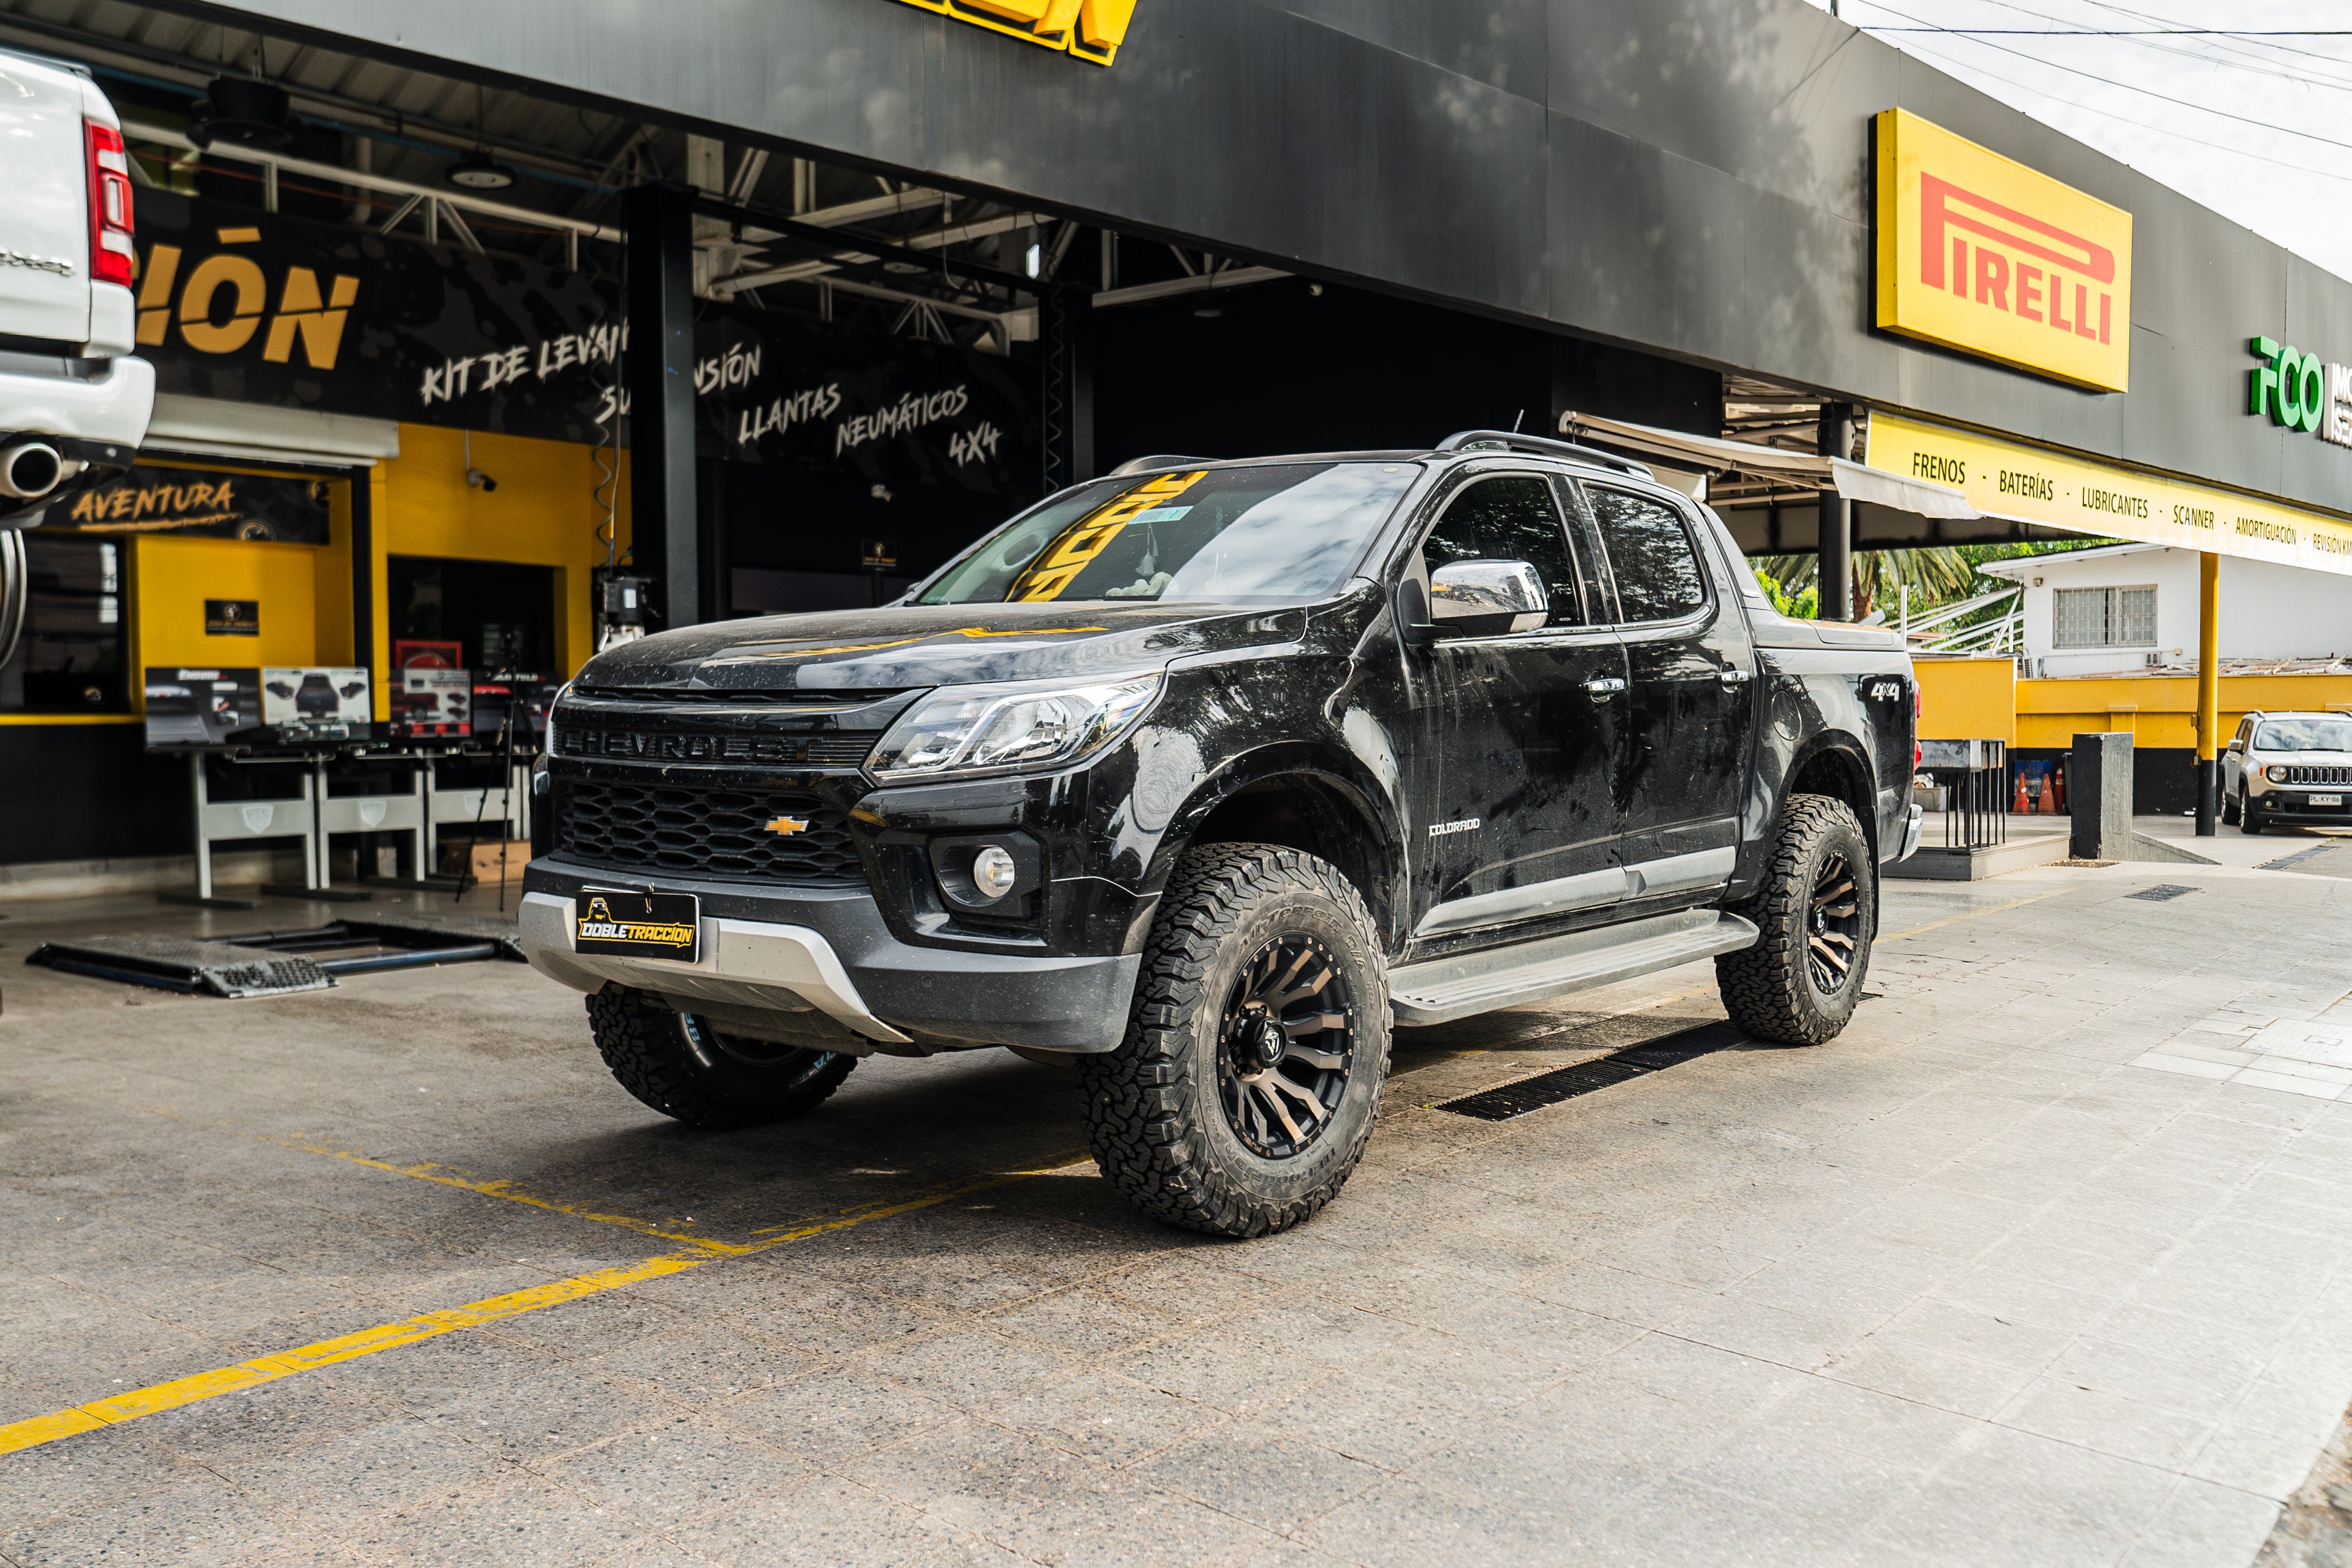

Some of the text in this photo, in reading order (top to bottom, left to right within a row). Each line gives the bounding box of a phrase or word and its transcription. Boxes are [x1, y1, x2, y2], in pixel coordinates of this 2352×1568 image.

[1920, 170, 2116, 347] PIRELLI
[132, 227, 360, 371] IÓN
[421, 316, 630, 407] KIT DE LEVAN
[738, 383, 841, 448] LLANTAS
[836, 384, 968, 457] NEUMÁTICOS
[949, 419, 1004, 469] 4X4
[70, 479, 236, 522] AVENTURA
[1913, 452, 1966, 485] FRENOS
[1999, 470, 2053, 501] BATERÍAS
[2082, 486, 2148, 519] LUBRICANTES
[2173, 504, 2215, 530] SCANNER
[2235, 516, 2297, 546] AMORTIGUACIÓN
[2313, 533, 2341, 554] REVISIÓN
[562, 728, 823, 764] CHEVROLET
[1428, 818, 1481, 838] COLORADO
[1242, 1131, 1263, 1153] FUEL
